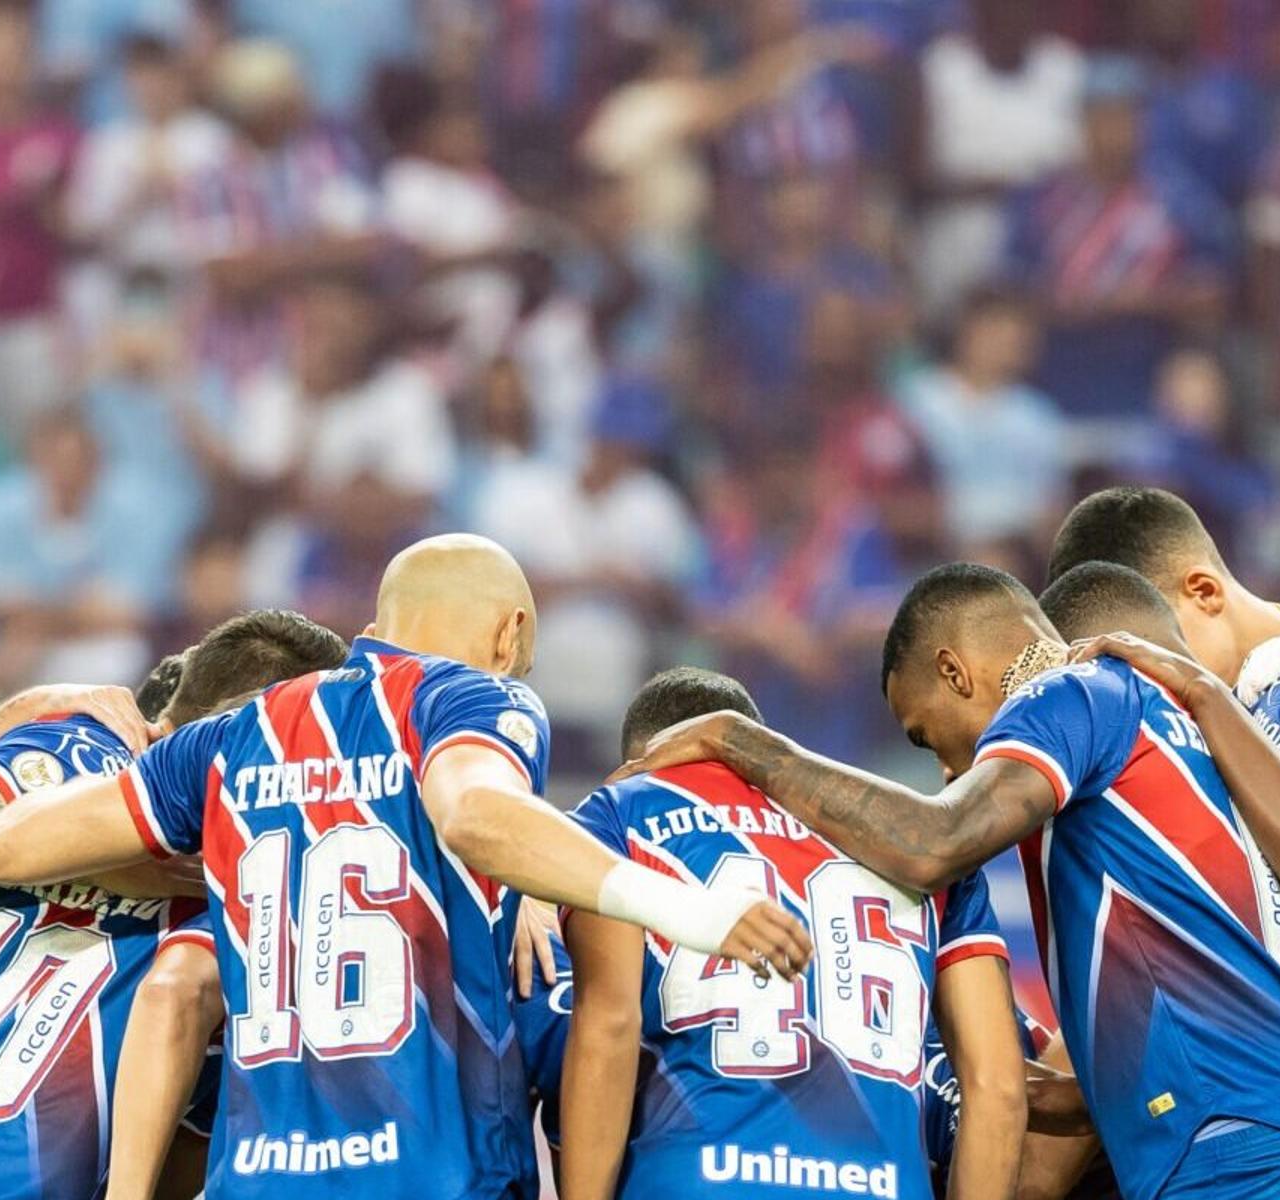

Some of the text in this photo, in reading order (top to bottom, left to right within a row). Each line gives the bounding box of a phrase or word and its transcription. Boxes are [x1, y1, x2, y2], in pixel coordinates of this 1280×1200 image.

[234, 752, 406, 812] THACIANO
[645, 804, 812, 846] LUCIANO
[232, 821, 417, 1071] 16
[258, 894, 274, 989] acelen
[314, 892, 335, 987] acelen
[659, 851, 932, 1092] 46
[832, 916, 855, 1002] acelen
[18, 981, 78, 1065] acelen
[233, 1121, 399, 1175] Unimed
[700, 1144, 898, 1200] Unimed
